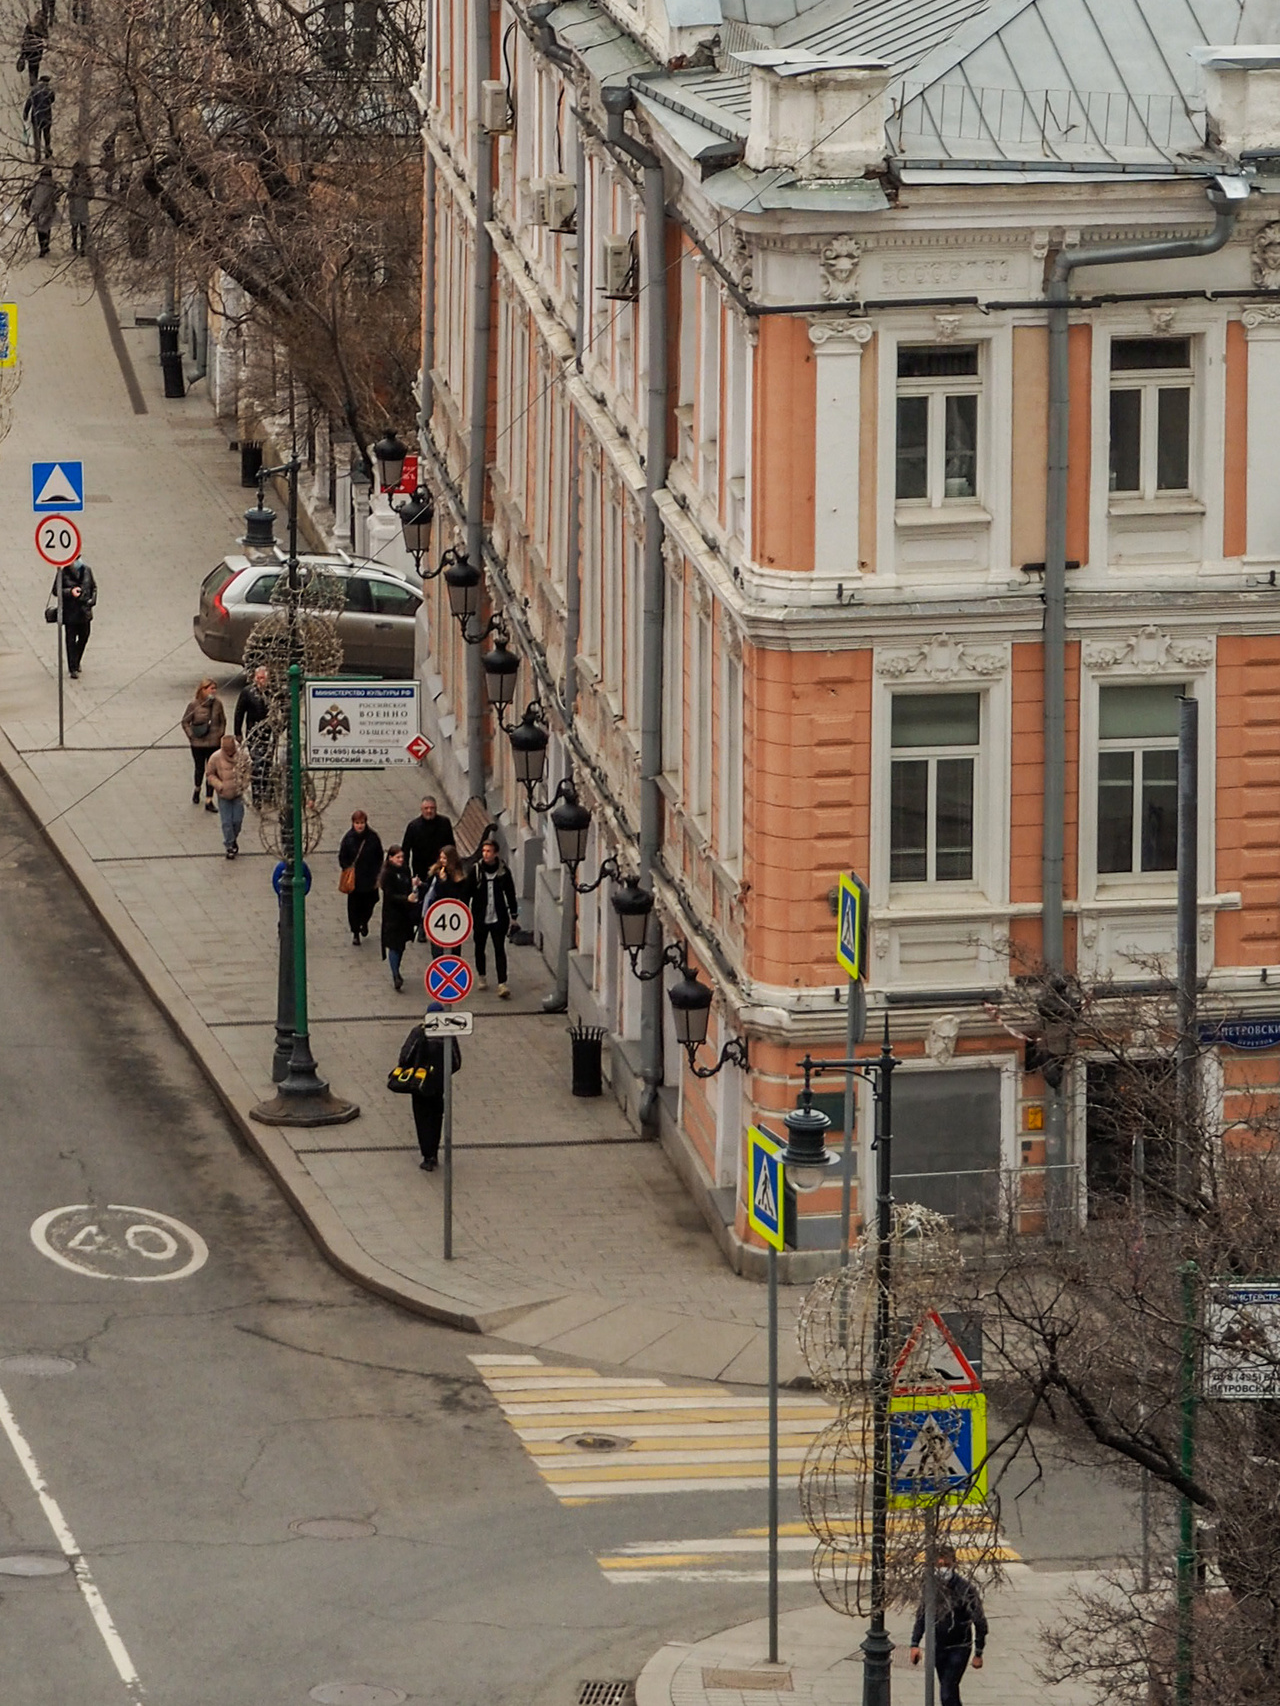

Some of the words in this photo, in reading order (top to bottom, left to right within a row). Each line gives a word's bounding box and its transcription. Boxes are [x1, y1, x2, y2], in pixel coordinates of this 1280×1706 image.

[44, 528, 72, 550] 20
[434, 913, 461, 931] 40
[1222, 1024, 1280, 1036] ПЕТРОВСКИ
